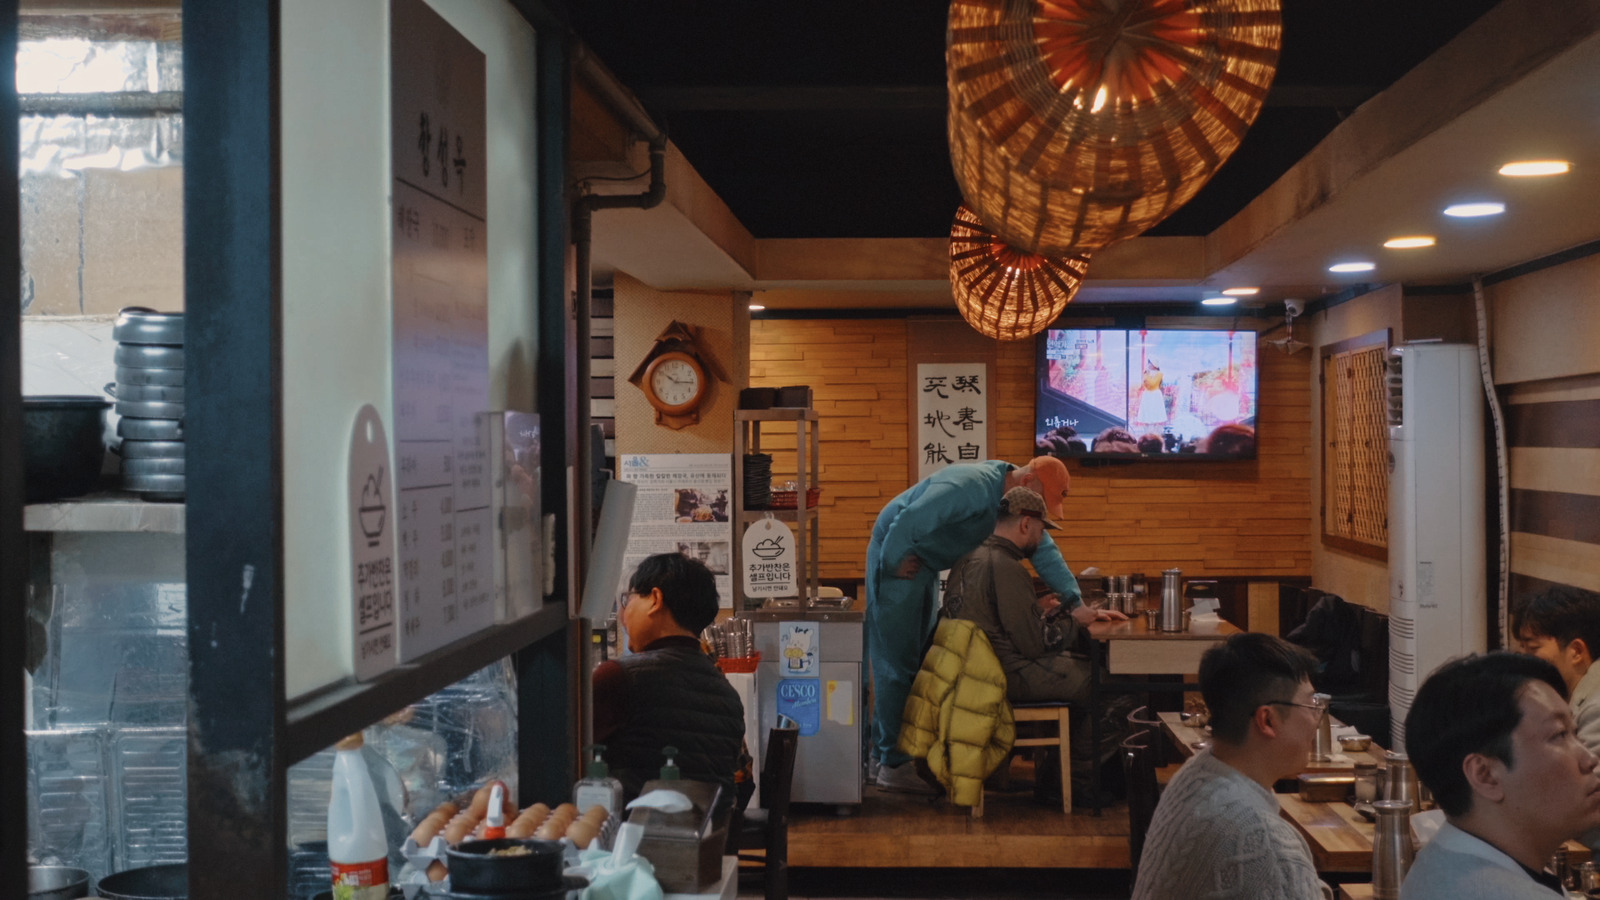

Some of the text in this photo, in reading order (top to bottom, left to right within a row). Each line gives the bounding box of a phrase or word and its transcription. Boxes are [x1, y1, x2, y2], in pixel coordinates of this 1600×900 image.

[749, 563, 791, 572] 추가반찬은
[749, 572, 791, 582] 셀프입니다
[781, 685, 815, 697] CESCO
